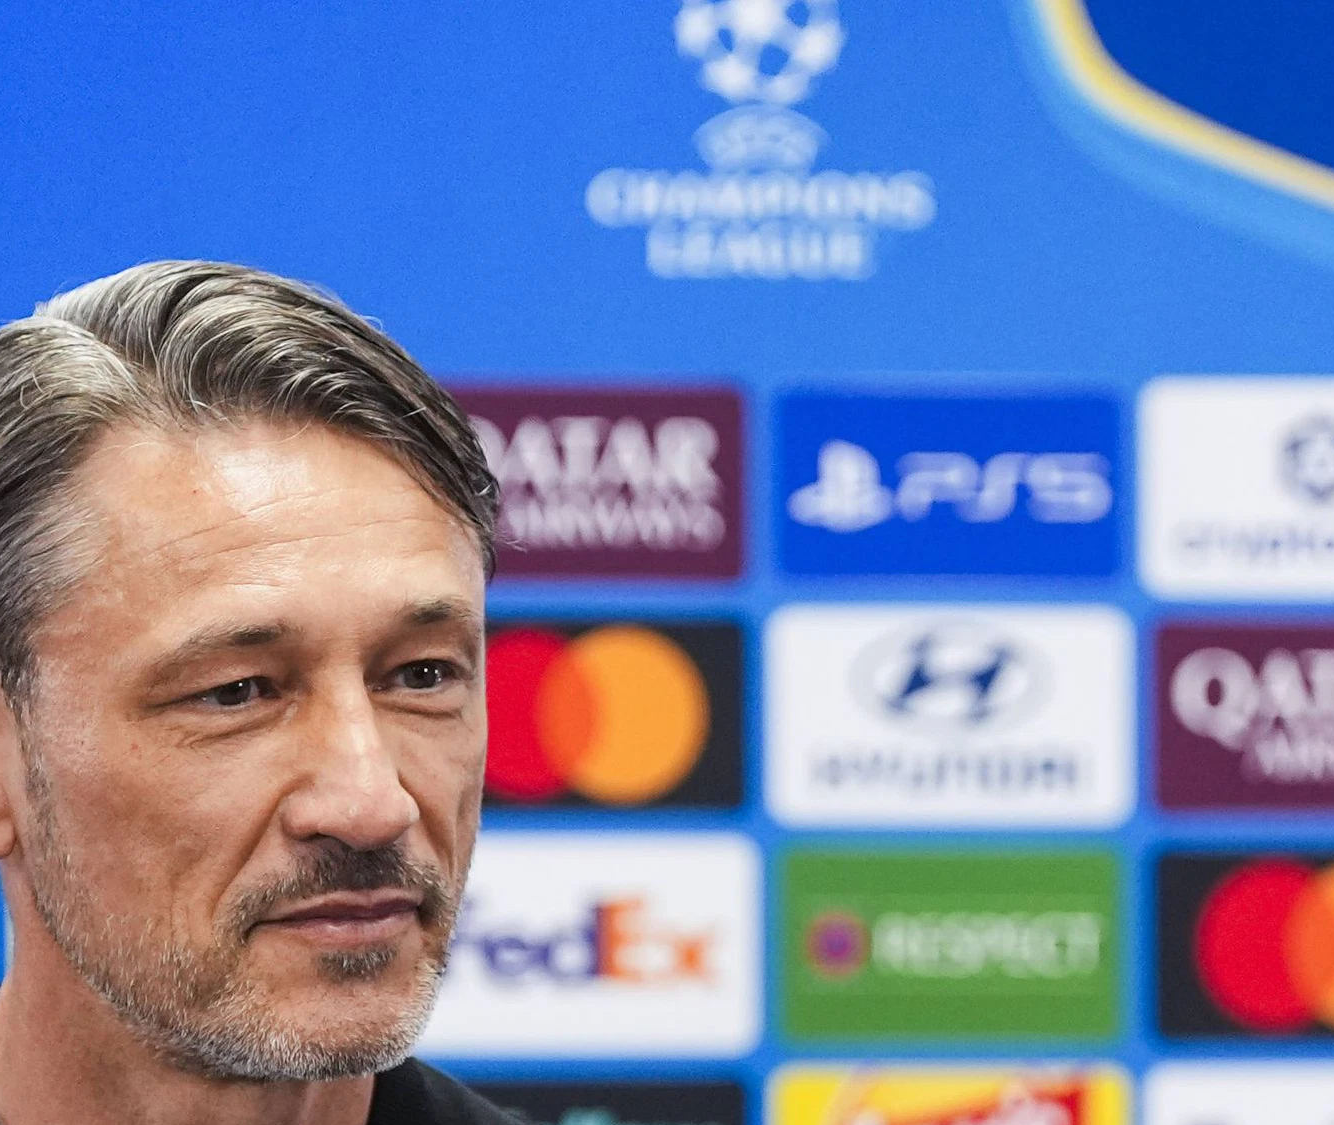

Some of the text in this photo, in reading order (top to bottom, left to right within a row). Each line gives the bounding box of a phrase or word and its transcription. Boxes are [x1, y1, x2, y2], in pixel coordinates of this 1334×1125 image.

[586, 169, 934, 230] CHAMPIONS
[646, 225, 875, 280] LEAGUE
[896, 451, 1112, 523] PS5
[873, 911, 1103, 980] RESPECT
